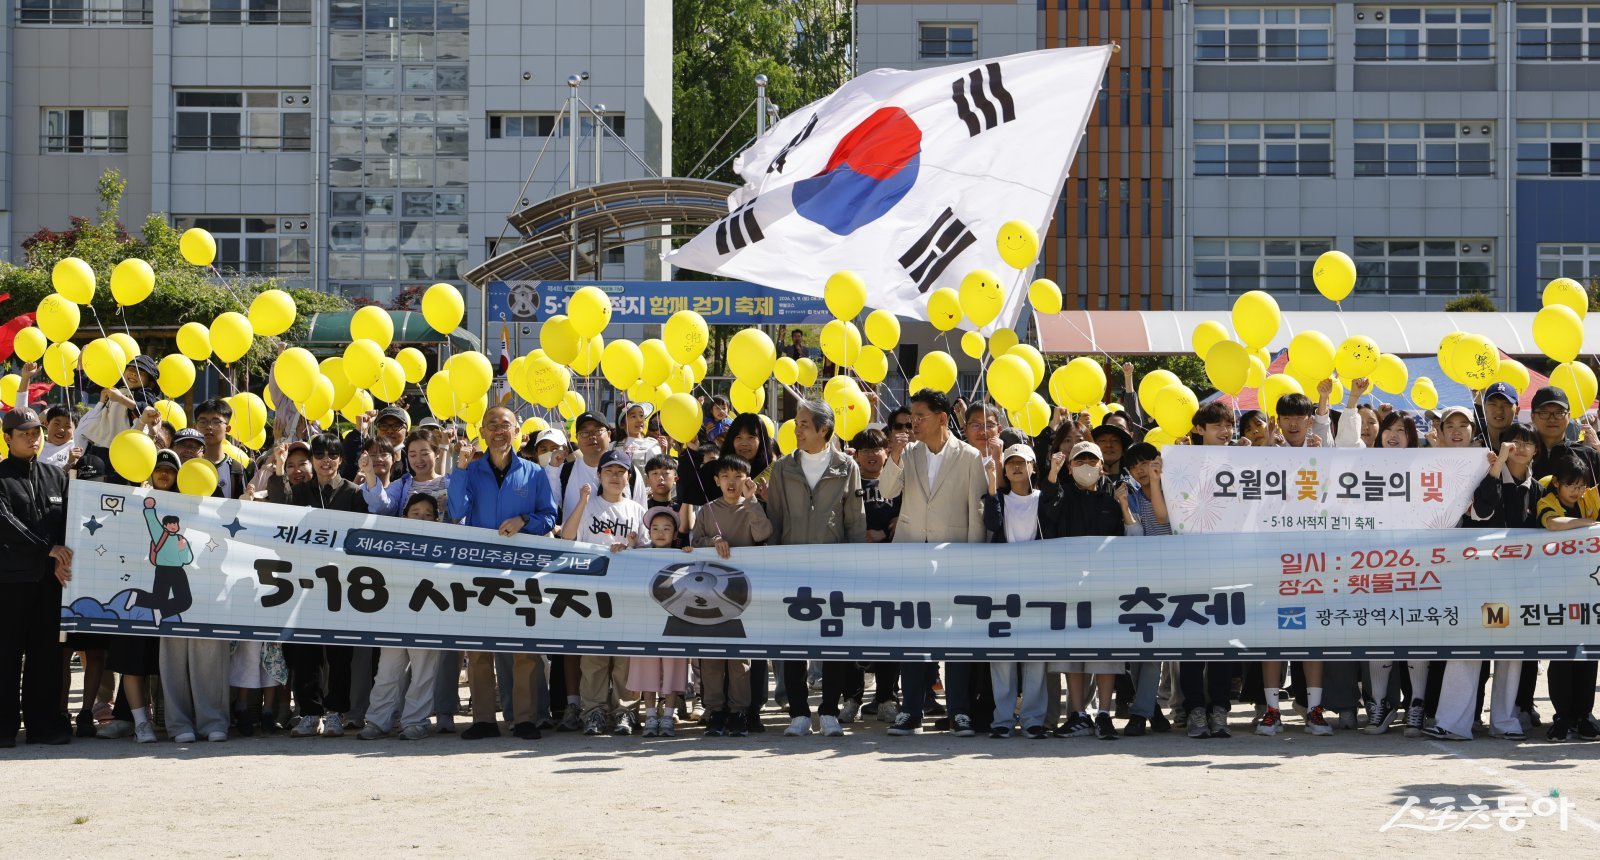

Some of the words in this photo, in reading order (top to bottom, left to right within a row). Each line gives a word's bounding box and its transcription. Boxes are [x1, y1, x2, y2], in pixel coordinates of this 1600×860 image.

[650, 296, 688, 316] 함께
[693, 296, 730, 316] 걷기
[735, 296, 773, 316] 축제
[1213, 469, 1287, 500] 오월의
[1295, 470, 1328, 503] 꽃,
[1336, 471, 1410, 502] 오늘의
[1420, 472, 1444, 502] 빛
[1296, 516, 1327, 529] 사적지
[1331, 516, 1351, 530] 걷기
[1354, 516, 1375, 530] 축제
[273, 525, 338, 548] 제4회
[355, 537, 428, 557] 제46주년
[431, 545, 553, 568] 5·18민주화운동
[557, 556, 592, 570] 기념
[1280, 552, 1326, 575] 일시
[1350, 549, 1420, 570] 2026.
[1430, 547, 1451, 565] 5.
[1462, 546, 1480, 560] 9.
[1492, 543, 1533, 560] (토)
[1278, 578, 1324, 596] 장소
[1347, 570, 1443, 595] 횃불코스
[408, 576, 613, 627] 사적지
[782, 586, 932, 637] 함께
[953, 594, 1092, 638] 걷기
[1118, 586, 1246, 643] 축제
[1315, 606, 1459, 627] 광주광역시교육청
